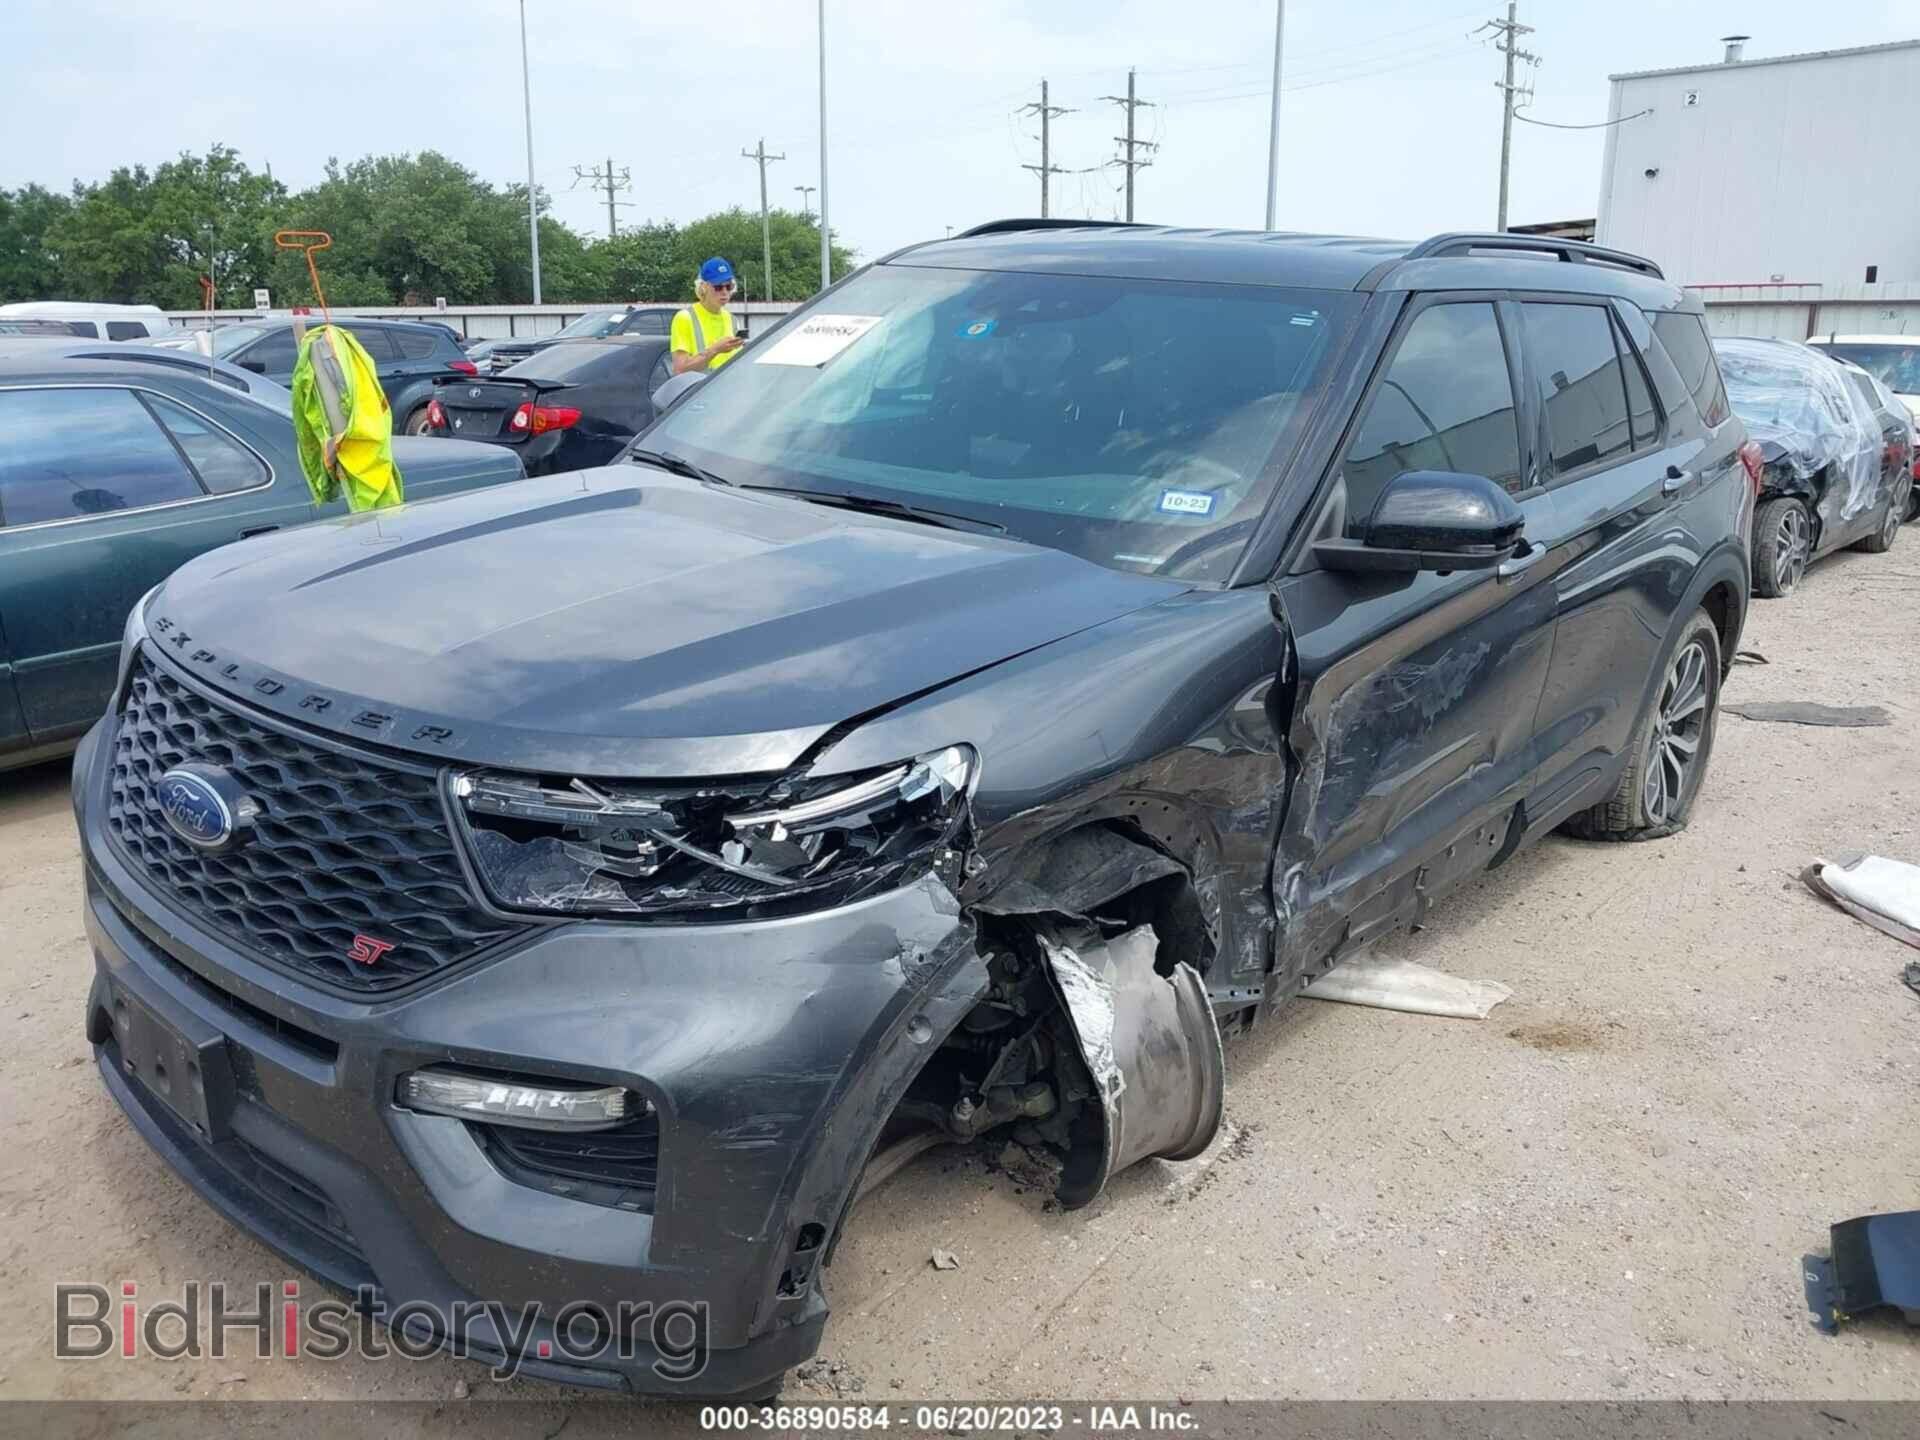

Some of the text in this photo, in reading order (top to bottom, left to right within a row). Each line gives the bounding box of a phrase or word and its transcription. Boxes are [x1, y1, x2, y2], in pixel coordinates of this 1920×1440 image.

[1687, 94, 1697, 105] 2
[154, 616, 454, 744] EXPLORER
[166, 783, 209, 832] Ford
[346, 934, 397, 965] ST
